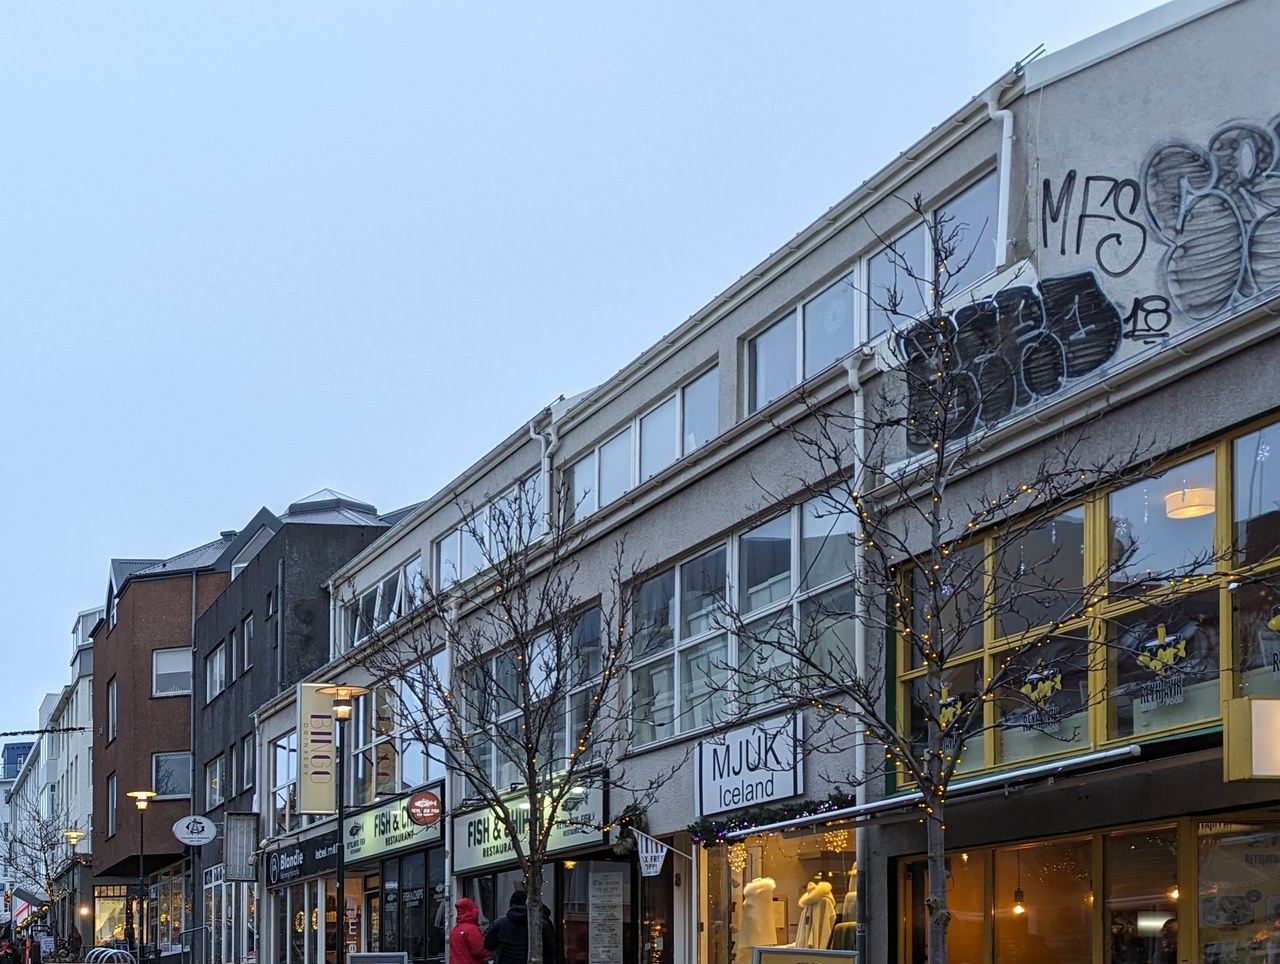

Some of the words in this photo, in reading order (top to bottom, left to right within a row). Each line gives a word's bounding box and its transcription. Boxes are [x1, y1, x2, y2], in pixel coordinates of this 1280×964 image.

[1041, 169, 1147, 277] MFS
[310, 714, 332, 783] BINGO
[712, 728, 781, 781] MJÚK
[719, 772, 774, 808] Iceland
[374, 810, 391, 838] FISH
[392, 814, 400, 832] &
[467, 816, 490, 848] FISH
[280, 849, 304, 870] Blondie
